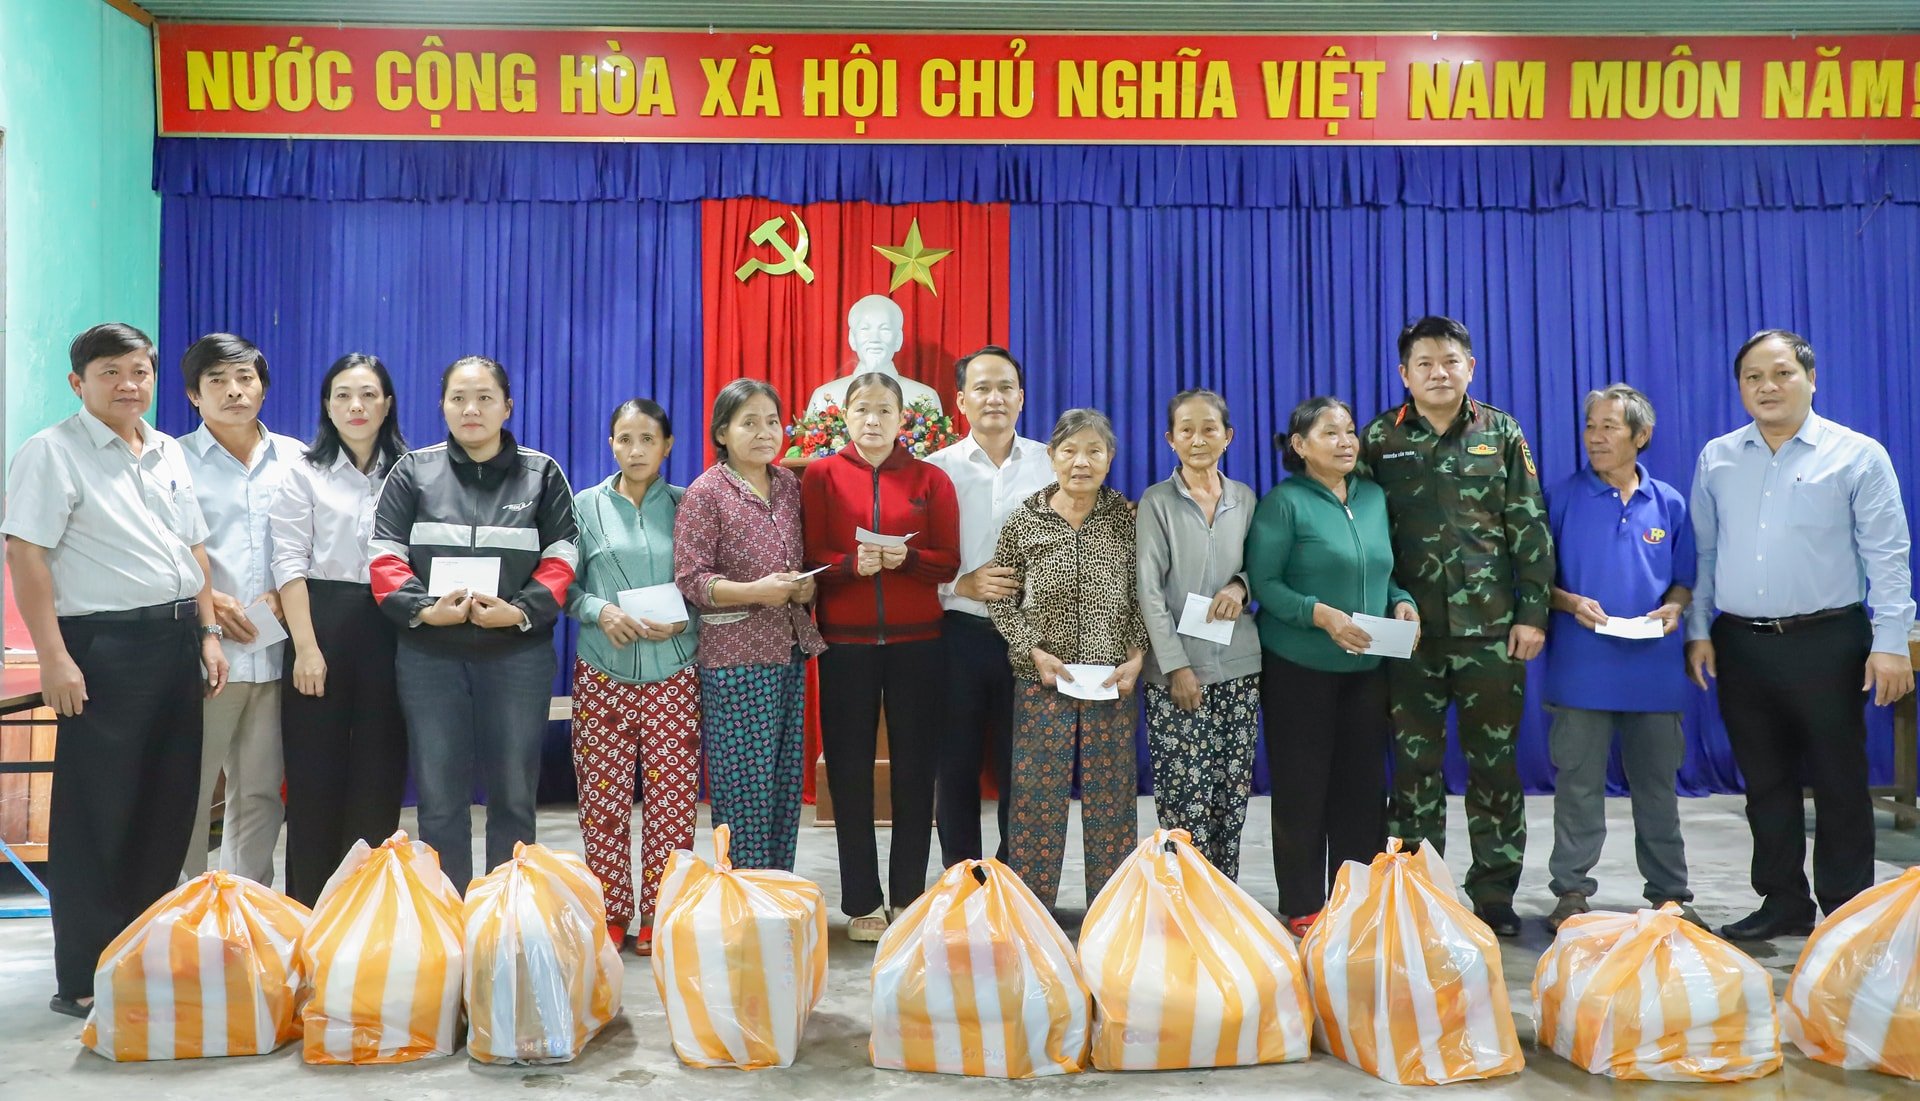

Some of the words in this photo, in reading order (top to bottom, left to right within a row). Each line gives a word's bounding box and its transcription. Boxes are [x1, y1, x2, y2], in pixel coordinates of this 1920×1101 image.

[185, 37, 353, 113] NƯỚC
[375, 36, 537, 128] CỘNG
[559, 41, 676, 115] HÒA
[699, 45, 781, 116] XÃ
[803, 44, 898, 134] HỘI
[920, 38, 1034, 118] CHỦ
[1058, 47, 1237, 119] NGHĨA
[1262, 45, 1386, 136] VIỆT
[1410, 61, 1547, 120] NAM
[1570, 44, 1741, 120] MUÔN
